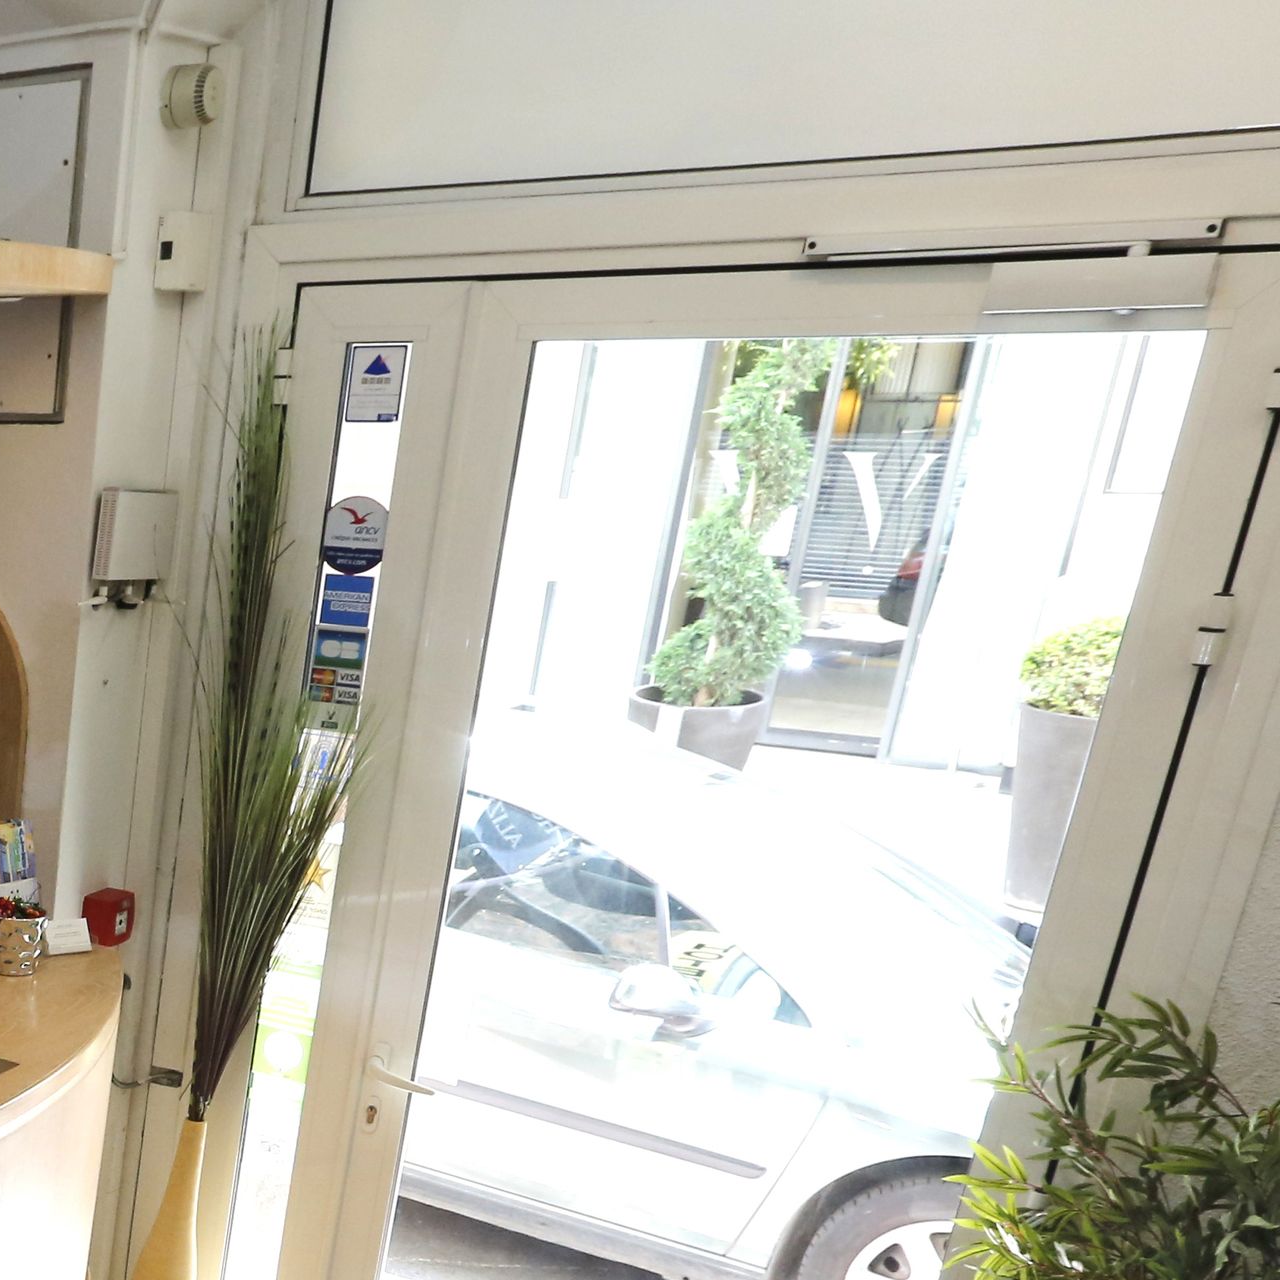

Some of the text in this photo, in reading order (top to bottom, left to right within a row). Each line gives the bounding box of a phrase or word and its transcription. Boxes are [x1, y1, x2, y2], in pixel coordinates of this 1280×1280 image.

[354, 526, 381, 535] ancv
[340, 672, 360, 683] VISA
[337, 689, 358, 700] VISA
